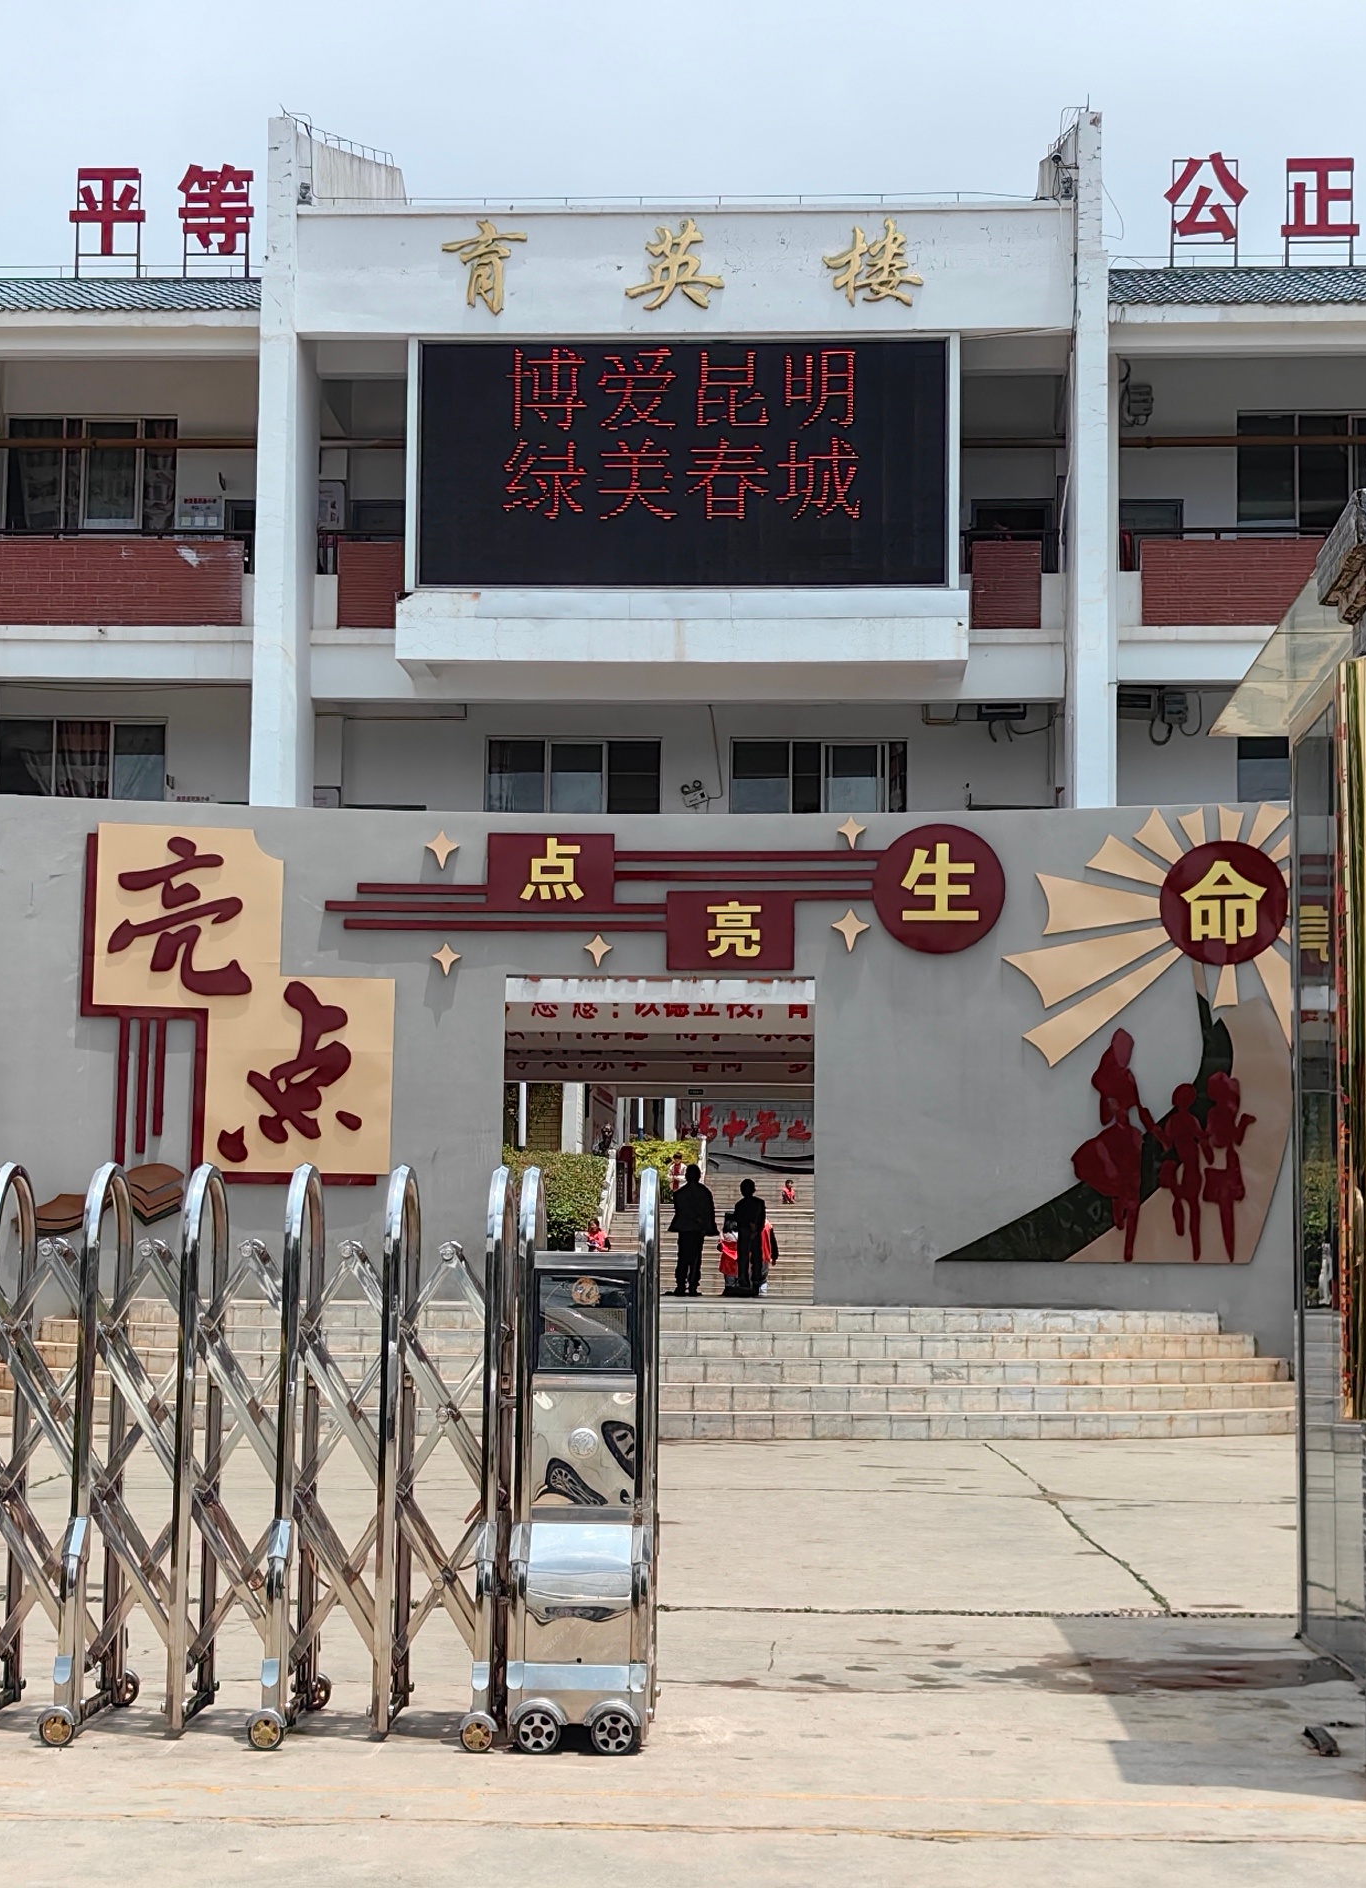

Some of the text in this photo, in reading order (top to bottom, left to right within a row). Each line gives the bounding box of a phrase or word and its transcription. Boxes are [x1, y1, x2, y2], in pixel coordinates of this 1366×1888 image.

[69, 164, 256, 256] 平等
[1163, 151, 1361, 241] 公正
[441, 217, 924, 316] 育英楼
[506, 346, 858, 432] 博爱昆明
[502, 436, 862, 522] 绿美春城
